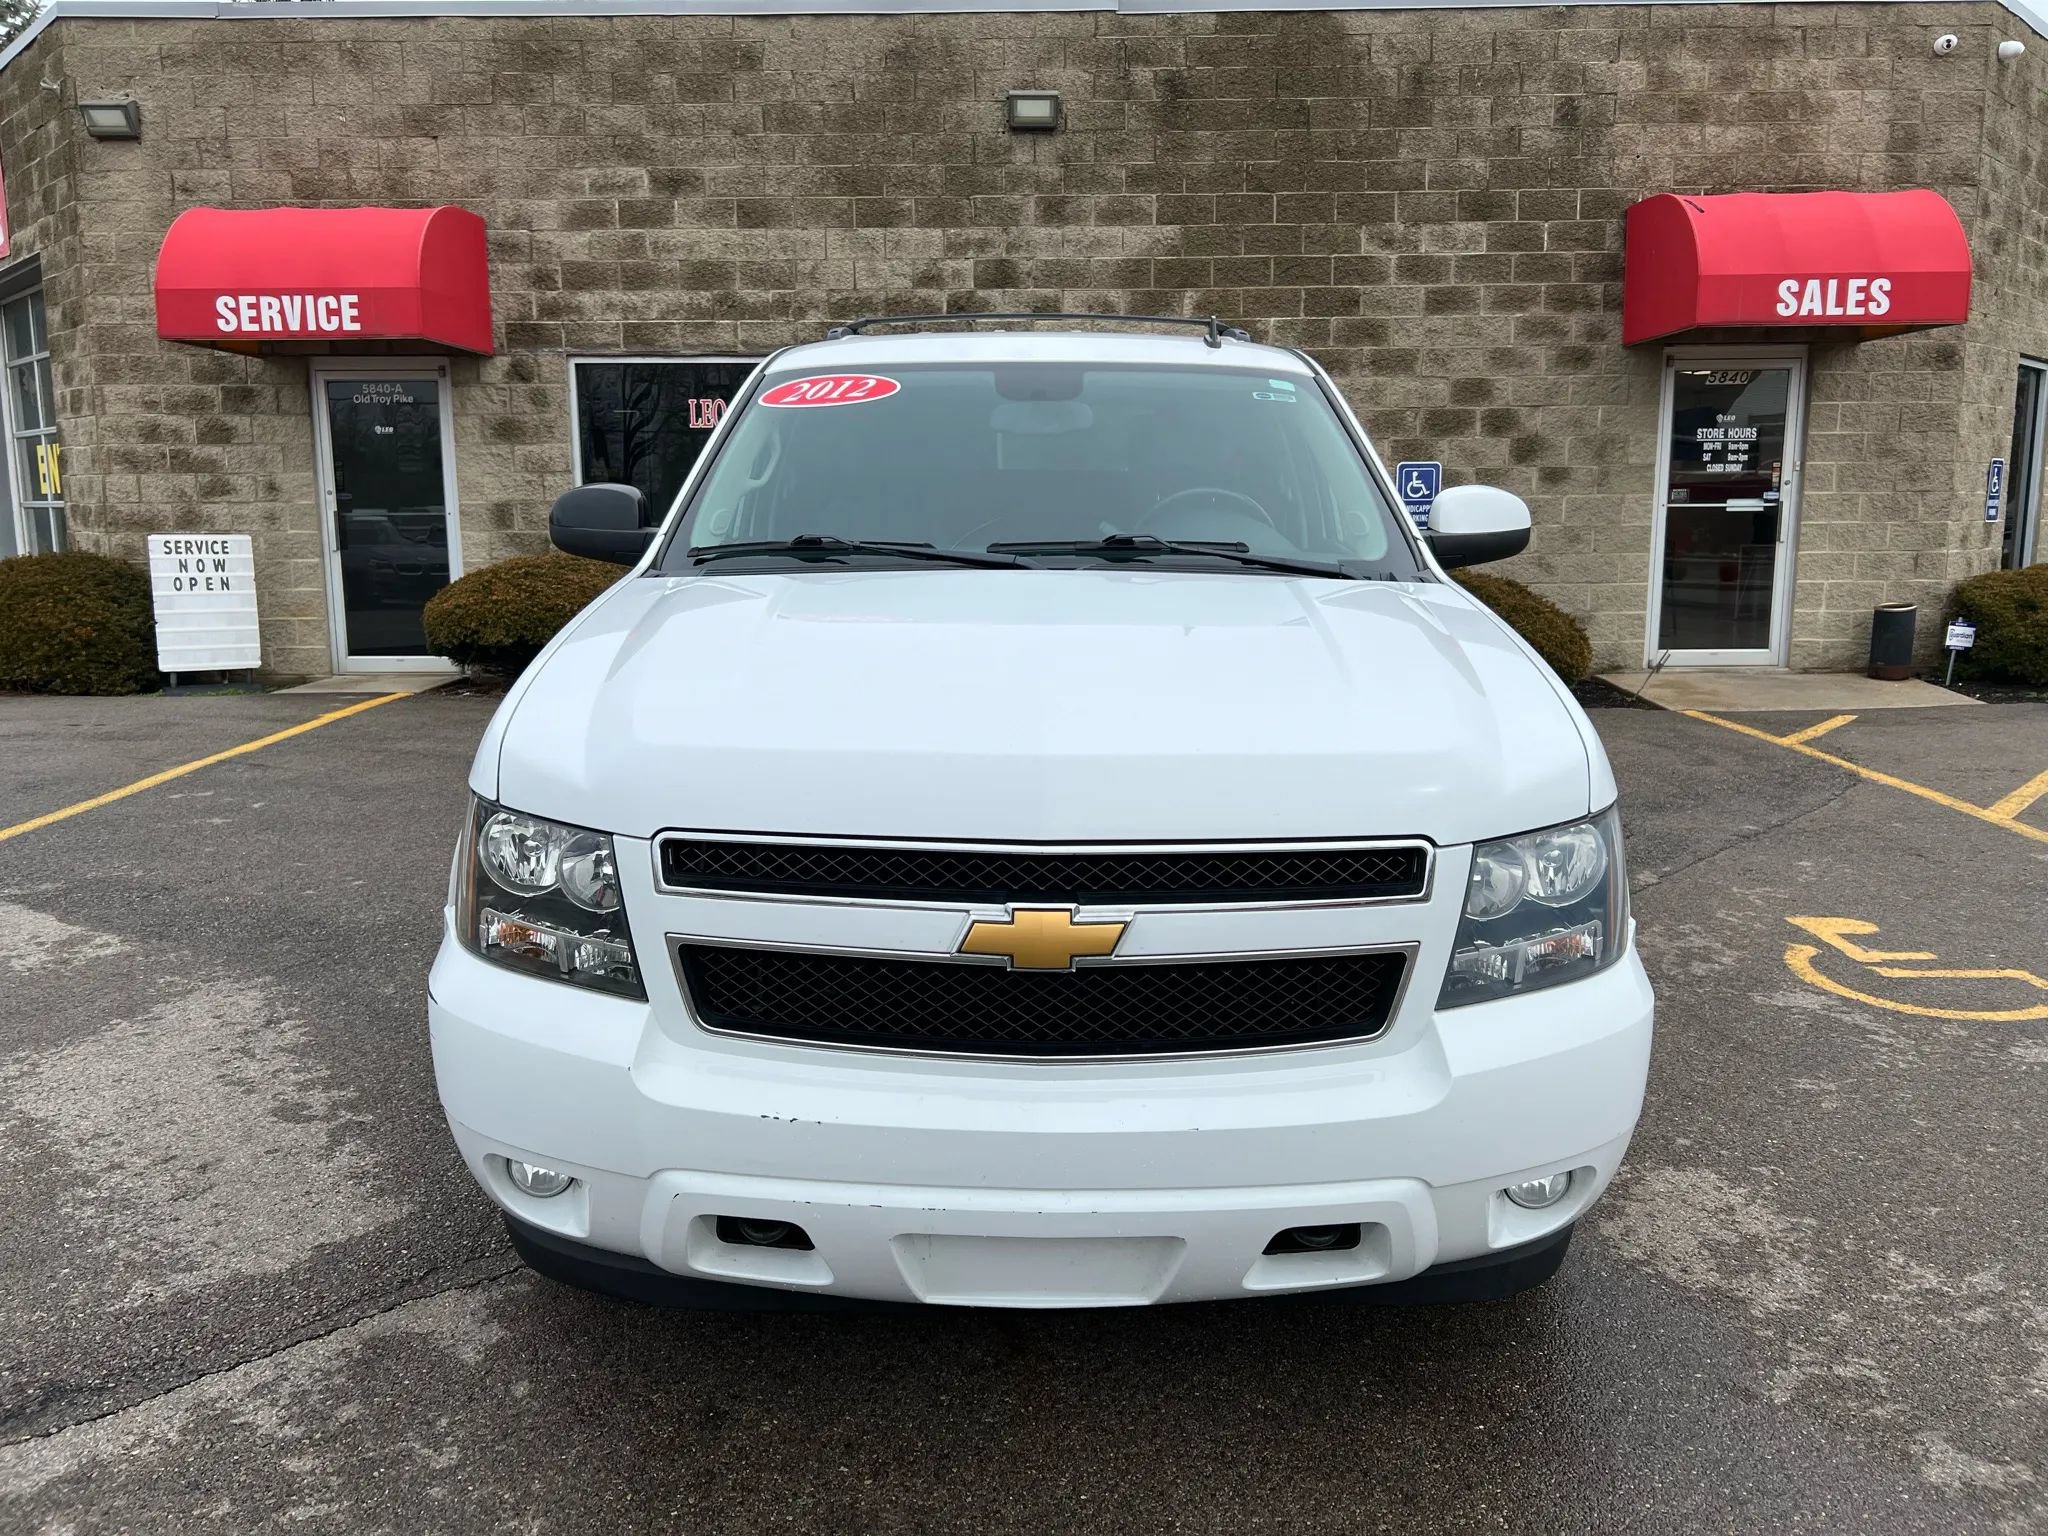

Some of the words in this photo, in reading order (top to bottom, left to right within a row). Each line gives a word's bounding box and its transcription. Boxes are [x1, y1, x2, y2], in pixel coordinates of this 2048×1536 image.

[1776, 278, 1892, 317] SALES
[215, 294, 361, 332] SERVICE
[1707, 371, 1749, 384] 5840
[362, 383, 403, 393] 5840-A
[780, 378, 877, 404] 2012
[353, 394, 370, 404] Old
[371, 394, 391, 406] Troy
[393, 394, 414, 404] Pike
[688, 399, 727, 428] LEO
[1696, 428, 1725, 439] STORE
[1728, 428, 1757, 439] HOURS
[1703, 442, 1722, 451] MON-FRI
[1702, 452, 1711, 462] SAT
[1706, 463, 1724, 473] CLOSED
[1725, 463, 1742, 473] SUNDAY
[1406, 504, 1431, 513] NDICAPP
[1412, 514, 1429, 522] RKING
[163, 540, 230, 555] SERVICE
[178, 558, 226, 573] NOW
[173, 576, 230, 592] OPEN
